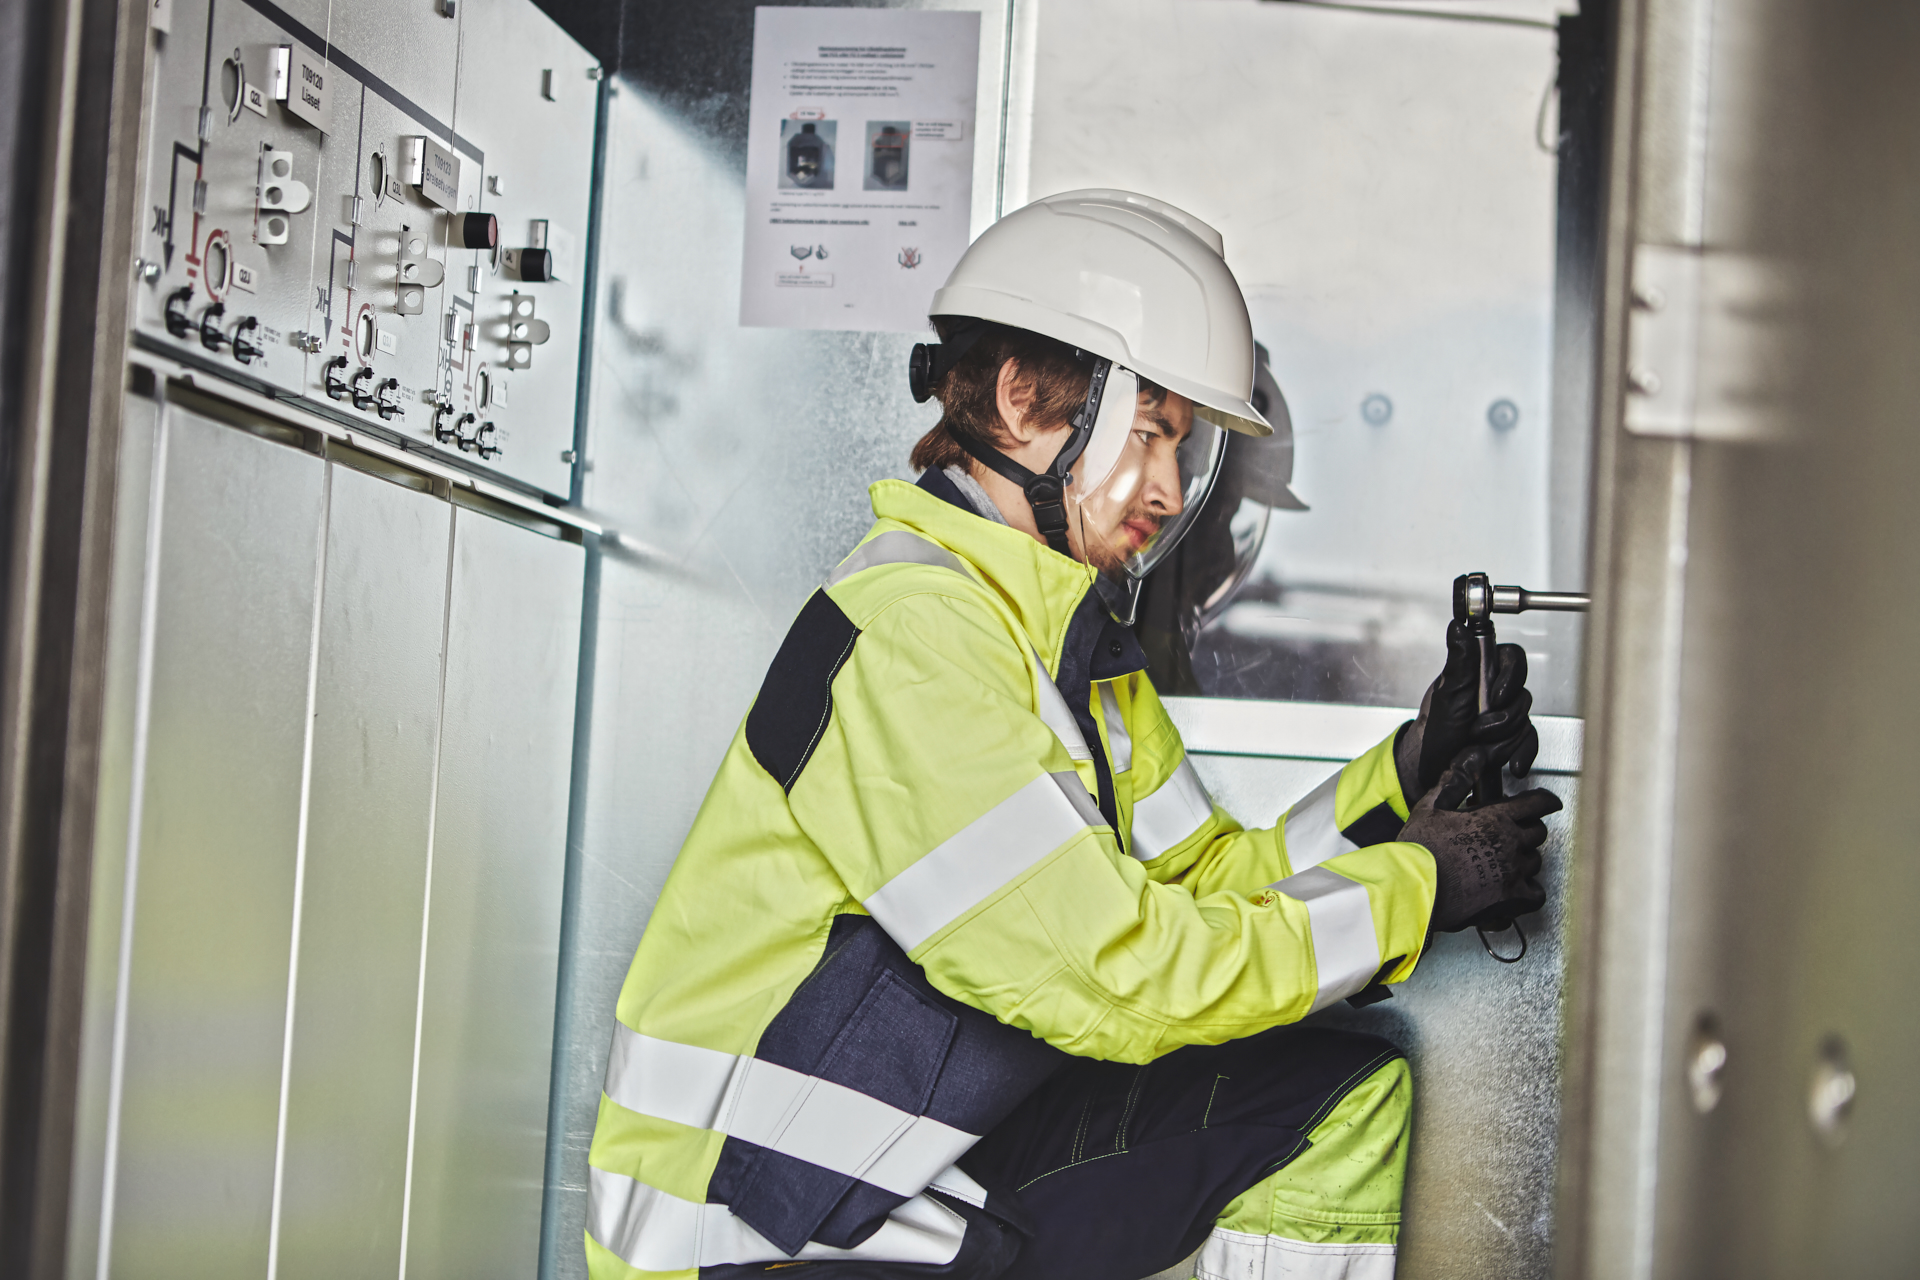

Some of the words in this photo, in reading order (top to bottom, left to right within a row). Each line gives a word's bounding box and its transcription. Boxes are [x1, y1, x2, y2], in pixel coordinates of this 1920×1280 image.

[302, 64, 323, 91] T09120
[250, 90, 262, 107] Q2L
[302, 86, 320, 111] Liaset
[434, 154, 452, 176] T09123
[392, 181, 402, 196] Q3L
